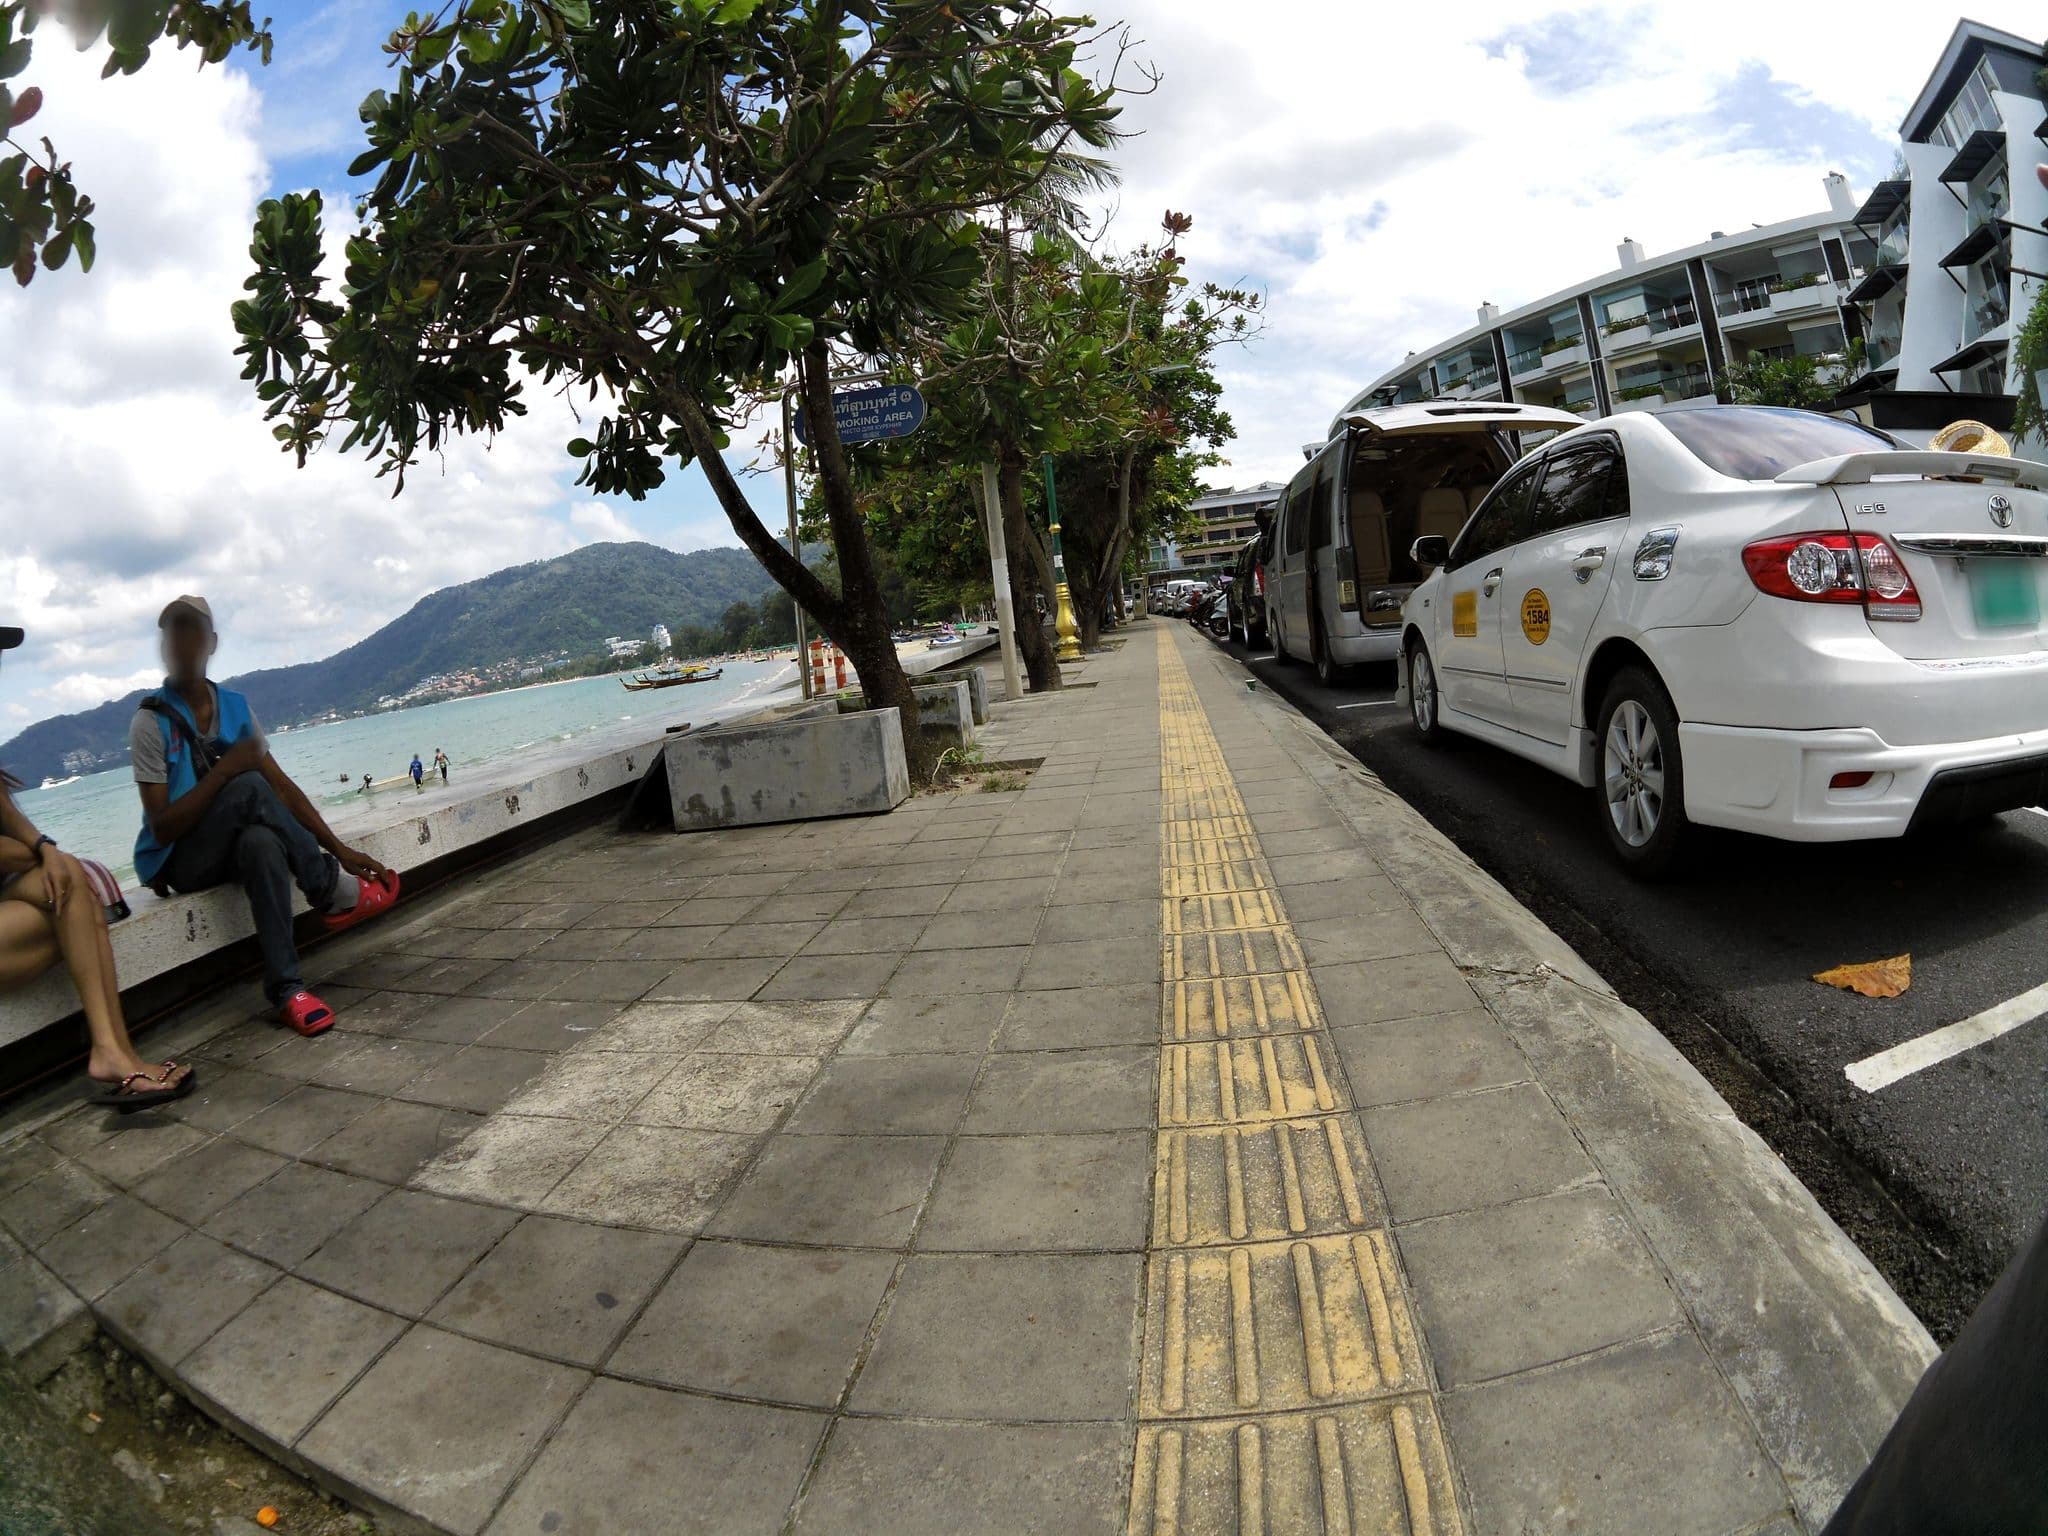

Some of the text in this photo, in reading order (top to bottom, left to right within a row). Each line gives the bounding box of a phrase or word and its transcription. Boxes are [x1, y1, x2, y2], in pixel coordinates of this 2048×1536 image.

[832, 388, 897, 417] นที่สูบบุหรี่
[836, 411, 914, 430] MOKING AREA
[1526, 609, 1549, 625] 1584
